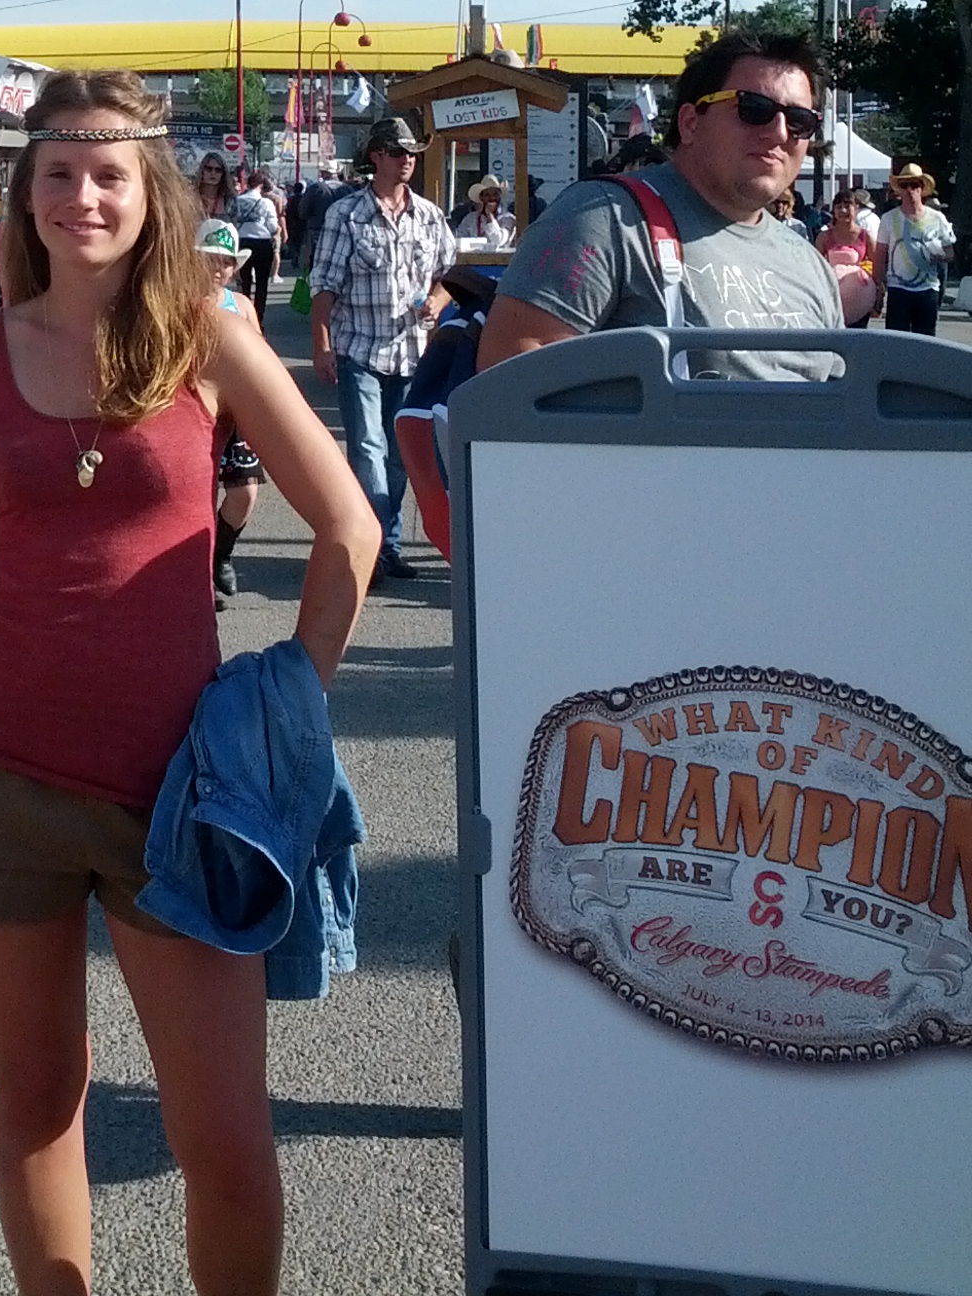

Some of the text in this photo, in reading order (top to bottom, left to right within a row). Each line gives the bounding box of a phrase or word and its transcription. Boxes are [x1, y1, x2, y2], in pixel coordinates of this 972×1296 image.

[446, 106, 508, 124] LOST KIDS
[454, 96, 479, 107] ATCO
[633, 701, 945, 800] WHAT KIND
[756, 740, 818, 775] OF
[637, 856, 713, 887] ARE
[821, 888, 914, 935] YOU?
[630, 916, 893, 1001] Calgary Stampede
[682, 984, 721, 1007] JULY
[783, 1012, 826, 1027] 2014
